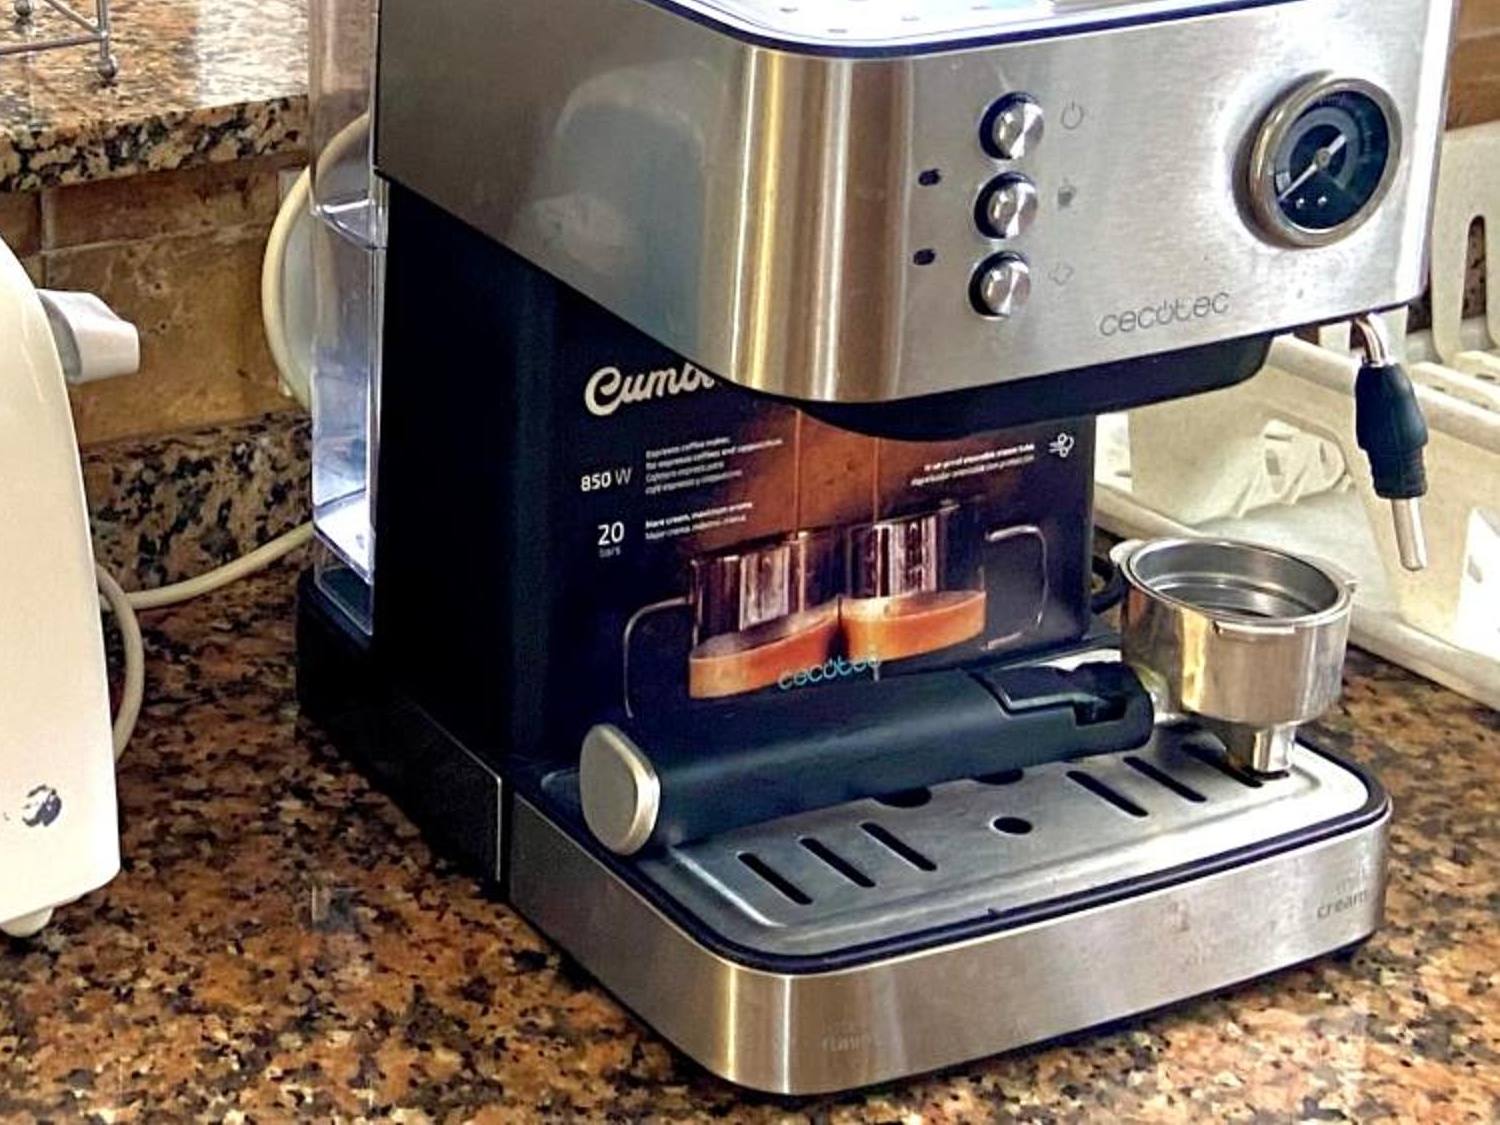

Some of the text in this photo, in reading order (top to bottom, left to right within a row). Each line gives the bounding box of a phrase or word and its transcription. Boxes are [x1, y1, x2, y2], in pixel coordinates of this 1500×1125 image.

[1099, 292, 1230, 337] cecotec
[584, 362, 716, 417] Cumb
[580, 467, 633, 492] 850 W
[597, 521, 625, 546] 20
